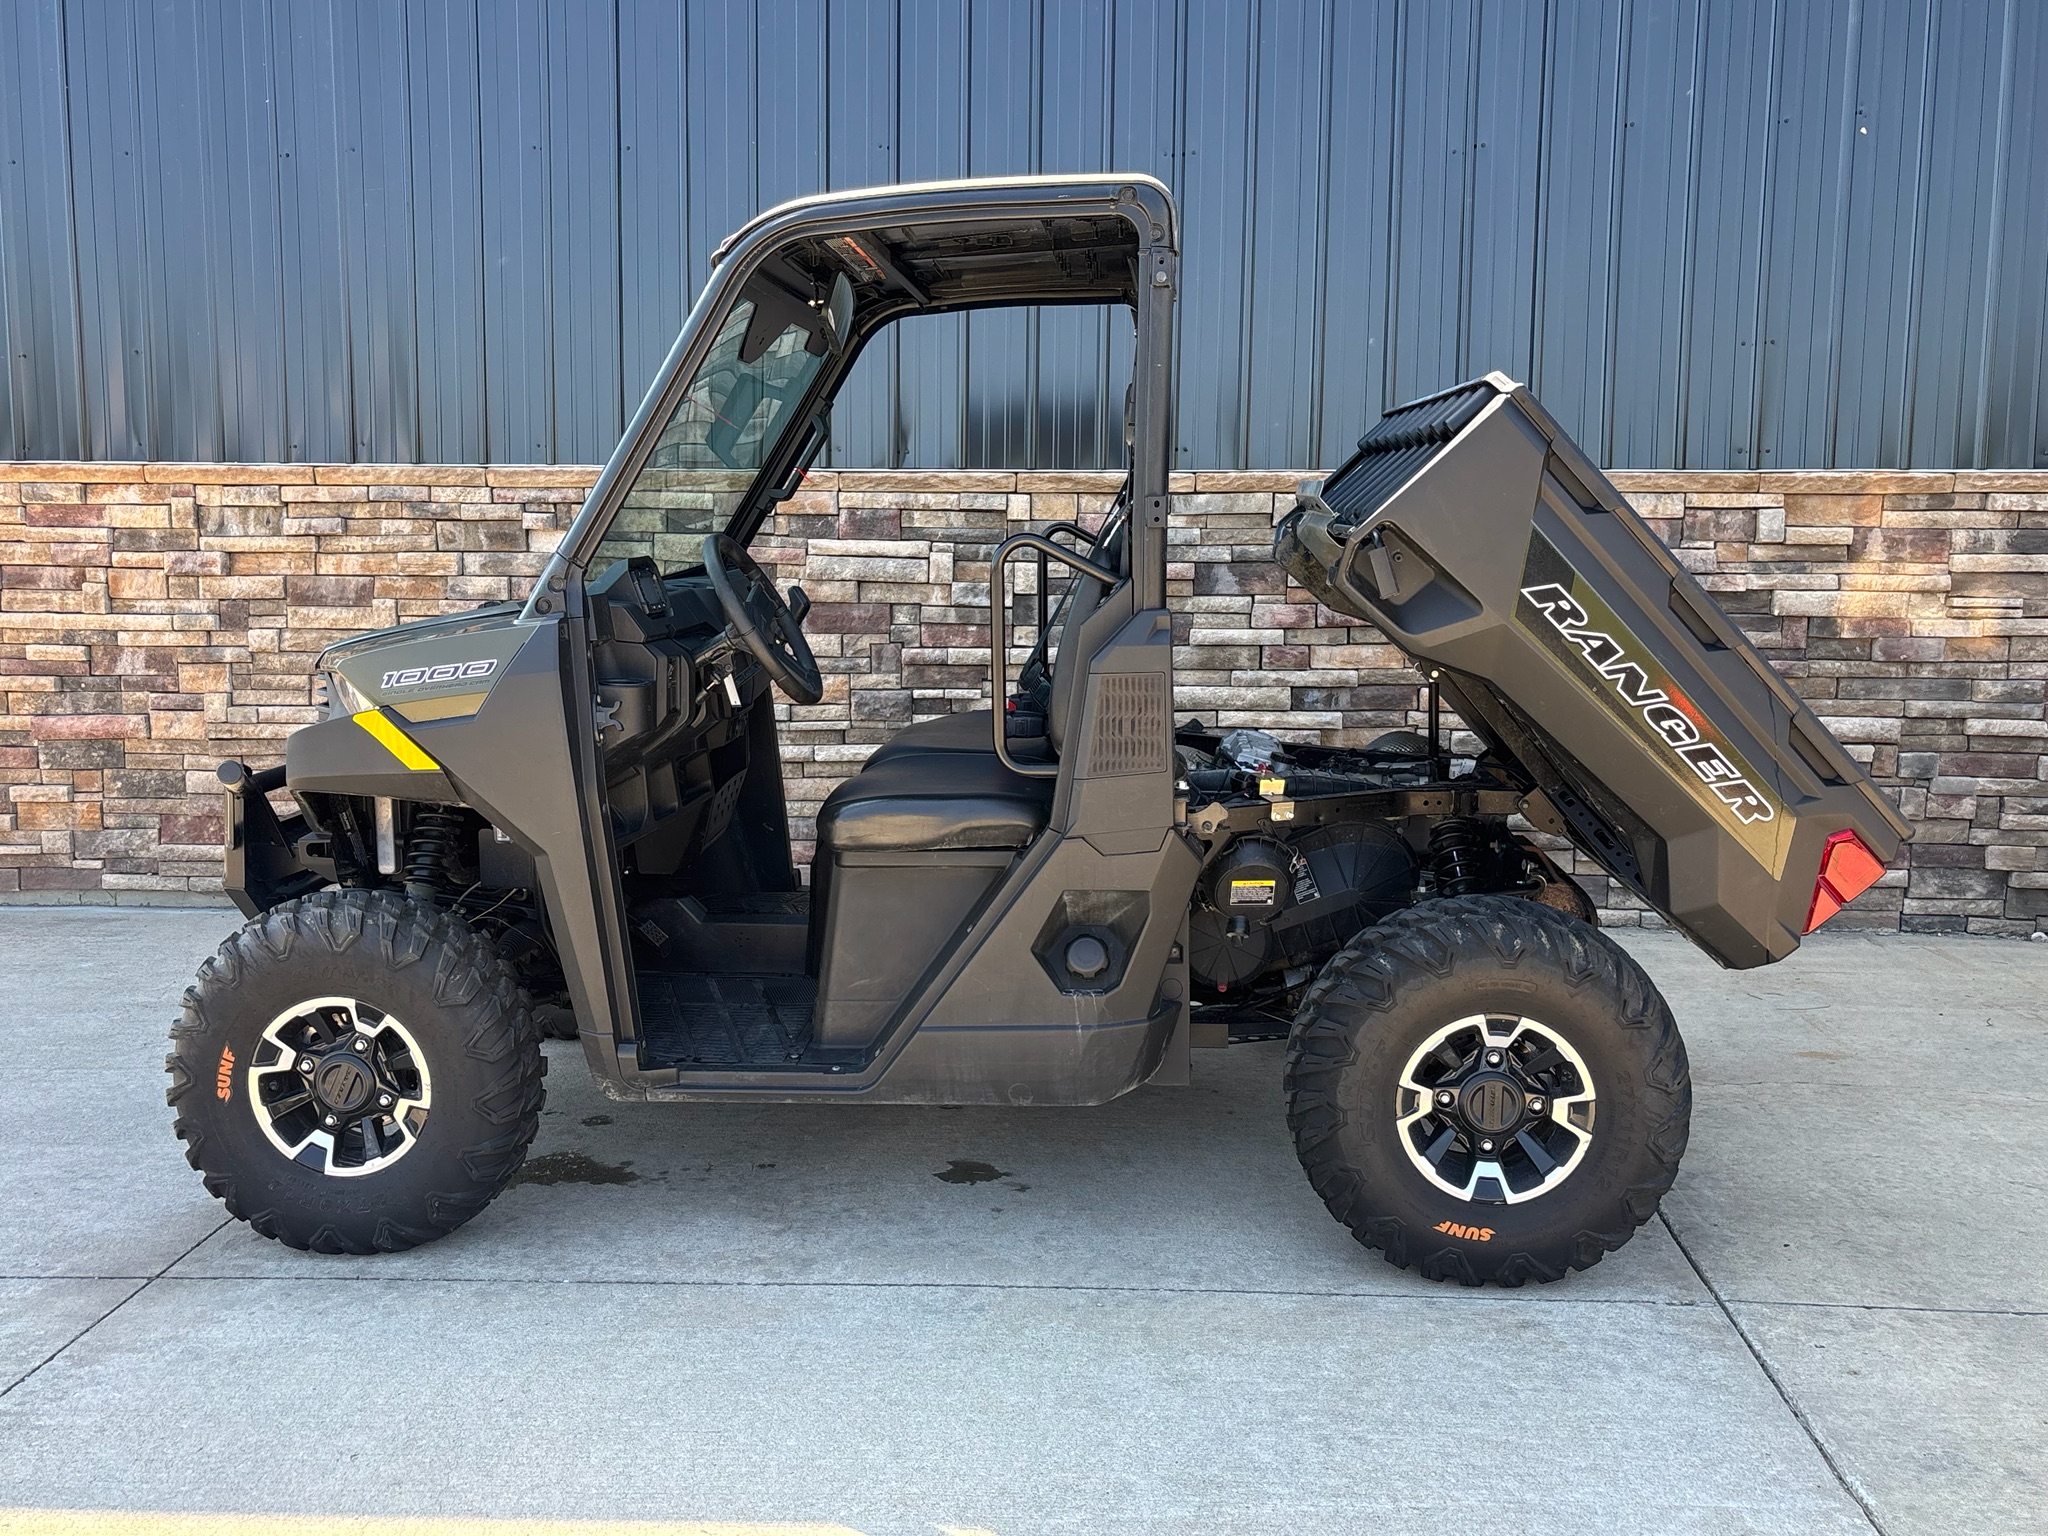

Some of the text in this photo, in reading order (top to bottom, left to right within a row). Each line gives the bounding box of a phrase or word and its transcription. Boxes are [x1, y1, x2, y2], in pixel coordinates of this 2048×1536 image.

[380, 658, 498, 689] 1000
[381, 679, 491, 697] SINGLE OVERHEAD CAM
[1520, 582, 1774, 825] RANGER
[216, 1045, 236, 1103] SUNF
[1432, 1220, 1497, 1242] SUNF
